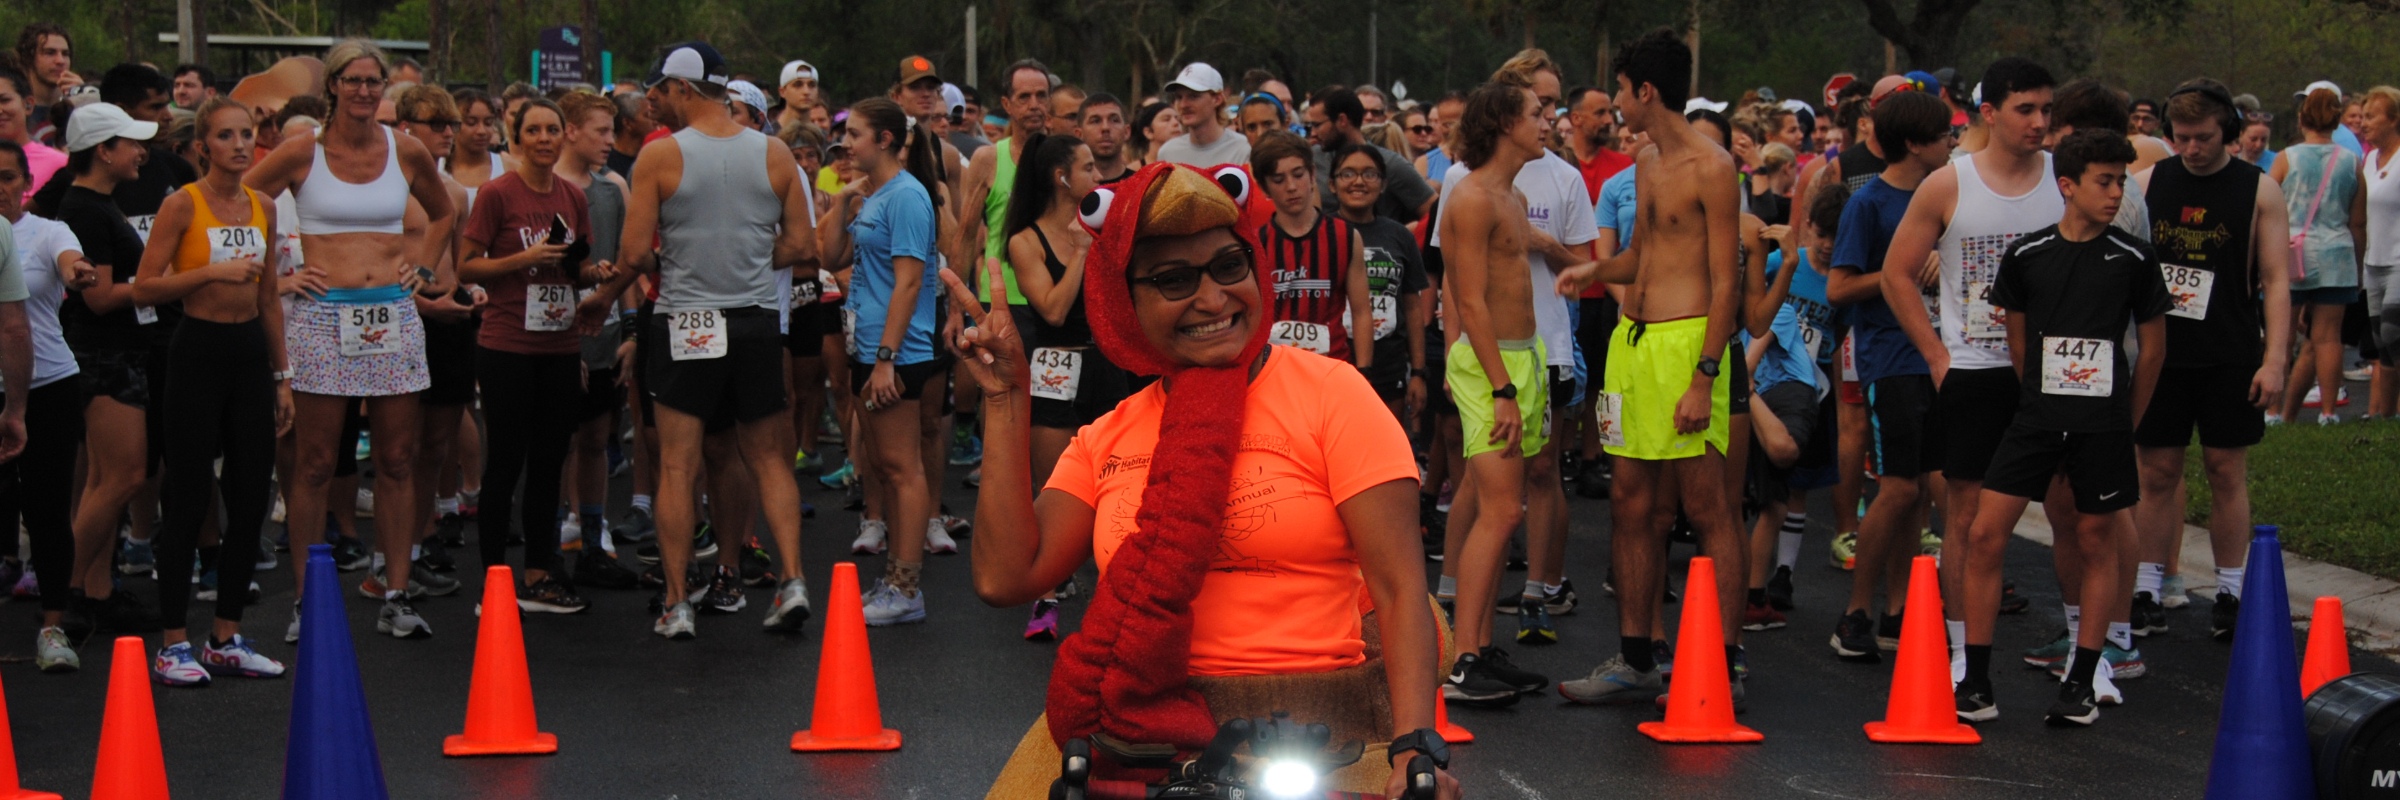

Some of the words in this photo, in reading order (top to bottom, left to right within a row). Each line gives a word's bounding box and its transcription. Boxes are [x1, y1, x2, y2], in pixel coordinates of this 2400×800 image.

[220, 228, 255, 247] 201
[1271, 265, 1308, 282] Track
[2163, 265, 2202, 288] 385
[538, 285, 567, 303] 267
[353, 307, 389, 327] 518
[679, 310, 714, 331] 288
[1279, 322, 1318, 341] 209
[1036, 349, 1073, 370] 434
[2054, 339, 2101, 361] 447
[1121, 456, 1151, 469] Habitat
